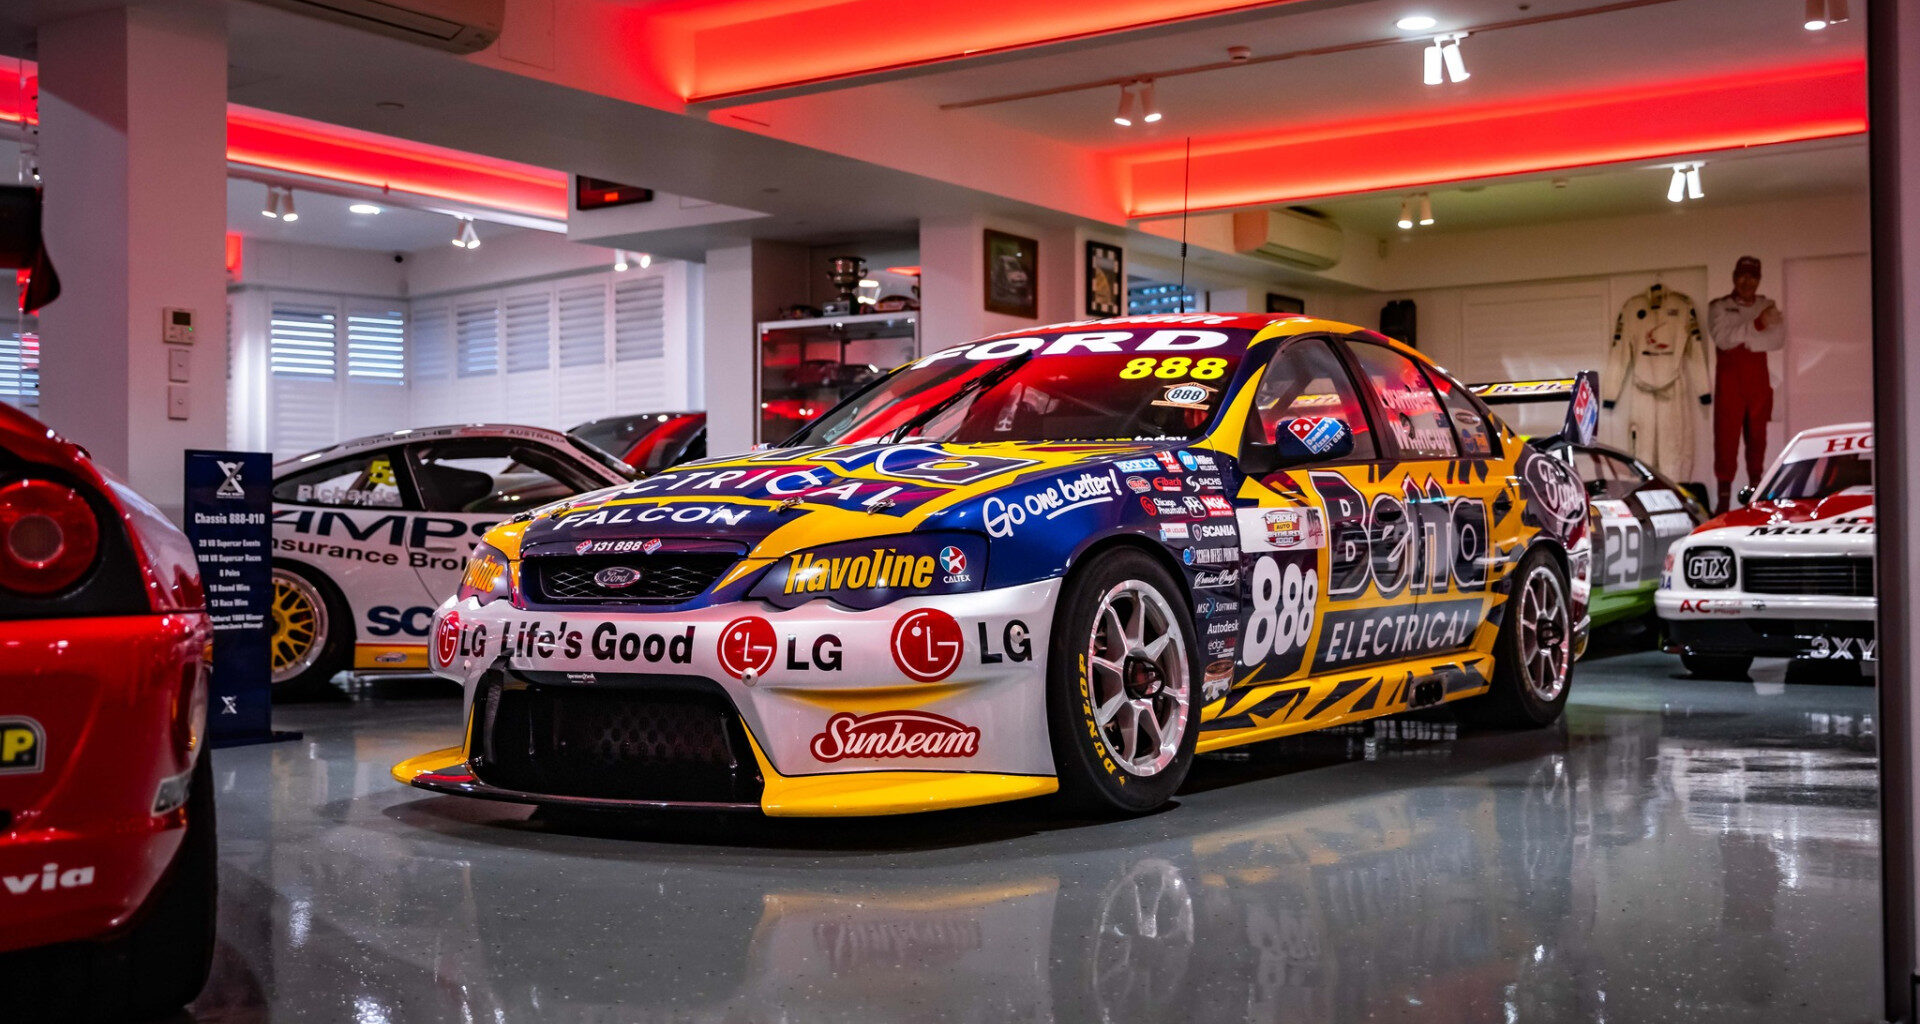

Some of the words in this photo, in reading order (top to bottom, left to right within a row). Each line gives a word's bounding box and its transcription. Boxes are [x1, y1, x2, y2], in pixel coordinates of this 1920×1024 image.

[911, 330, 1229, 370] FORD
[1119, 357, 1228, 379] 888
[1171, 388, 1202, 401] 888
[345, 428, 452, 450] PORSCHE
[508, 427, 566, 444] AUSTRALIA
[1536, 457, 1584, 519] Ford
[982, 496, 1026, 538] Go
[1024, 487, 1063, 515] one
[1057, 468, 1123, 502] better!
[195, 512, 227, 524] Chassis
[553, 506, 751, 530] FALCON
[1202, 525, 1237, 538] SCANIA
[592, 541, 614, 551] 131
[614, 541, 642, 551] 888
[1606, 525, 1641, 584] 29
[602, 569, 631, 583] Ford
[783, 548, 936, 595] Havoline
[942, 574, 972, 584] CALTEX
[1689, 556, 1730, 579] GTX
[1243, 556, 1318, 667] 888
[1680, 599, 1711, 613] AC
[1207, 619, 1239, 634] Autodesk
[1325, 609, 1470, 663] ELECTRICAL
[459, 624, 488, 658] LG
[500, 621, 583, 659] Life's
[592, 621, 696, 664] Good
[786, 633, 843, 671] LG
[977, 620, 1033, 664] LG
[1207, 639, 1225, 652] edge
[814, 714, 978, 758] Sunbeam
[2, 862, 95, 894] via
